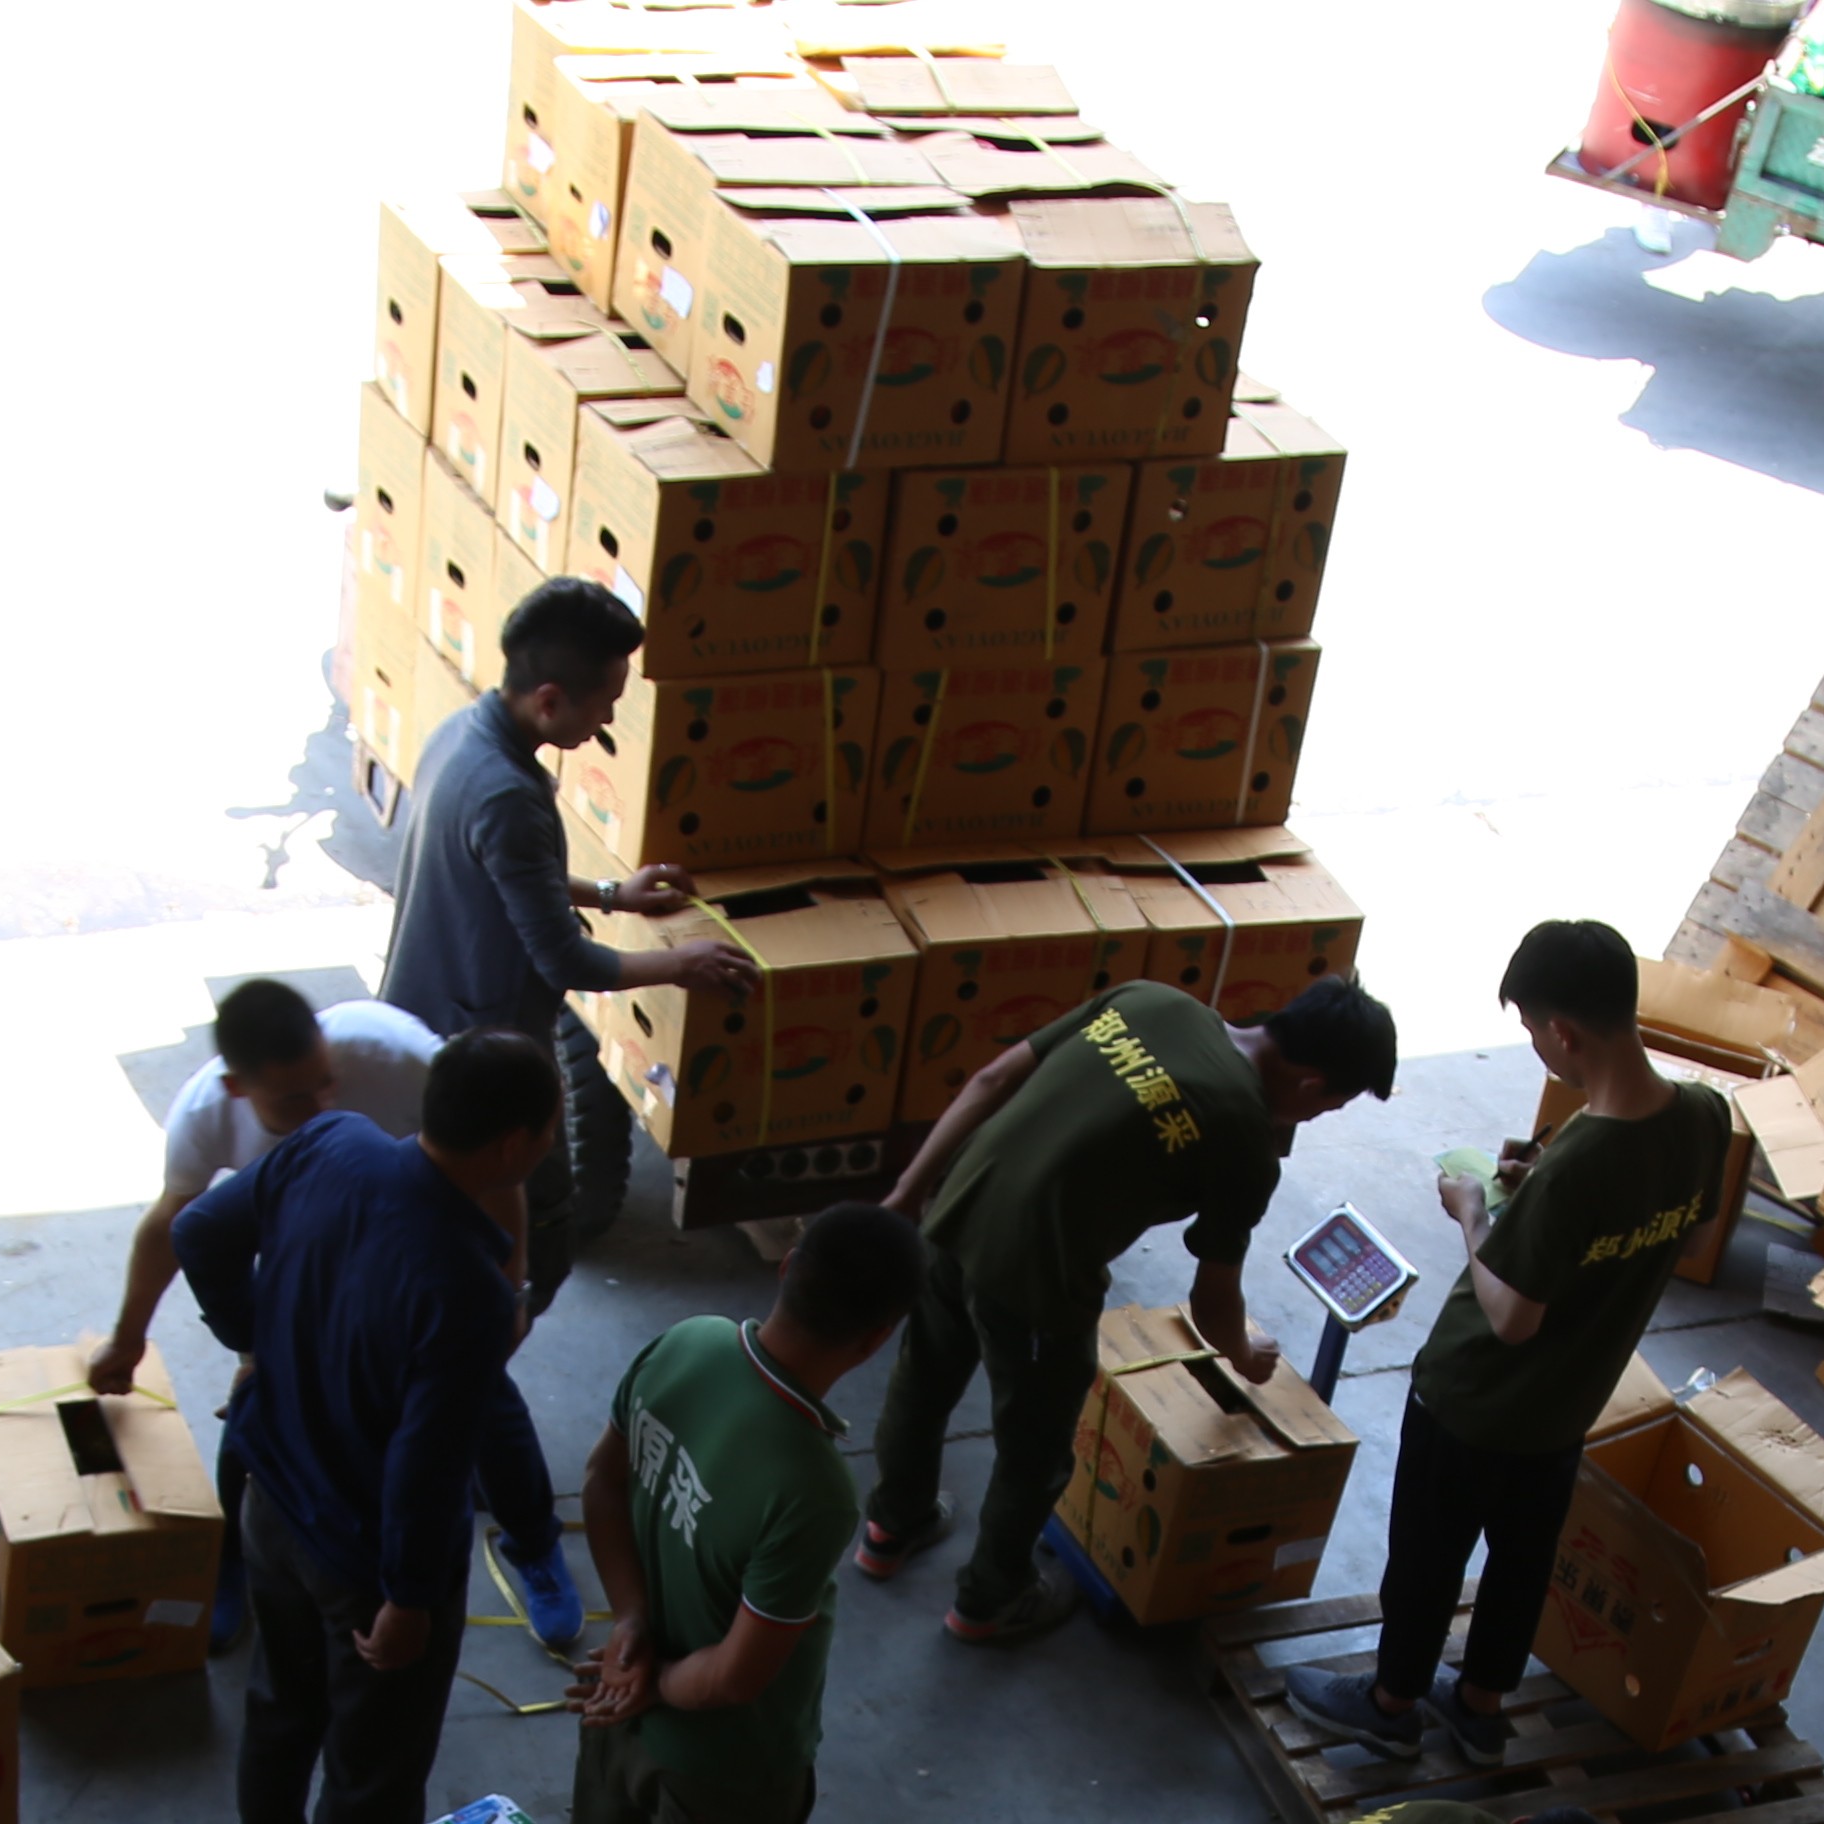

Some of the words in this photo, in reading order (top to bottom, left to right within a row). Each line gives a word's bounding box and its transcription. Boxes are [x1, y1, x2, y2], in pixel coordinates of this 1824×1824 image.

[1081, 1008, 1201, 1155] 郑州源采
[629, 1397, 713, 1551] 源采
